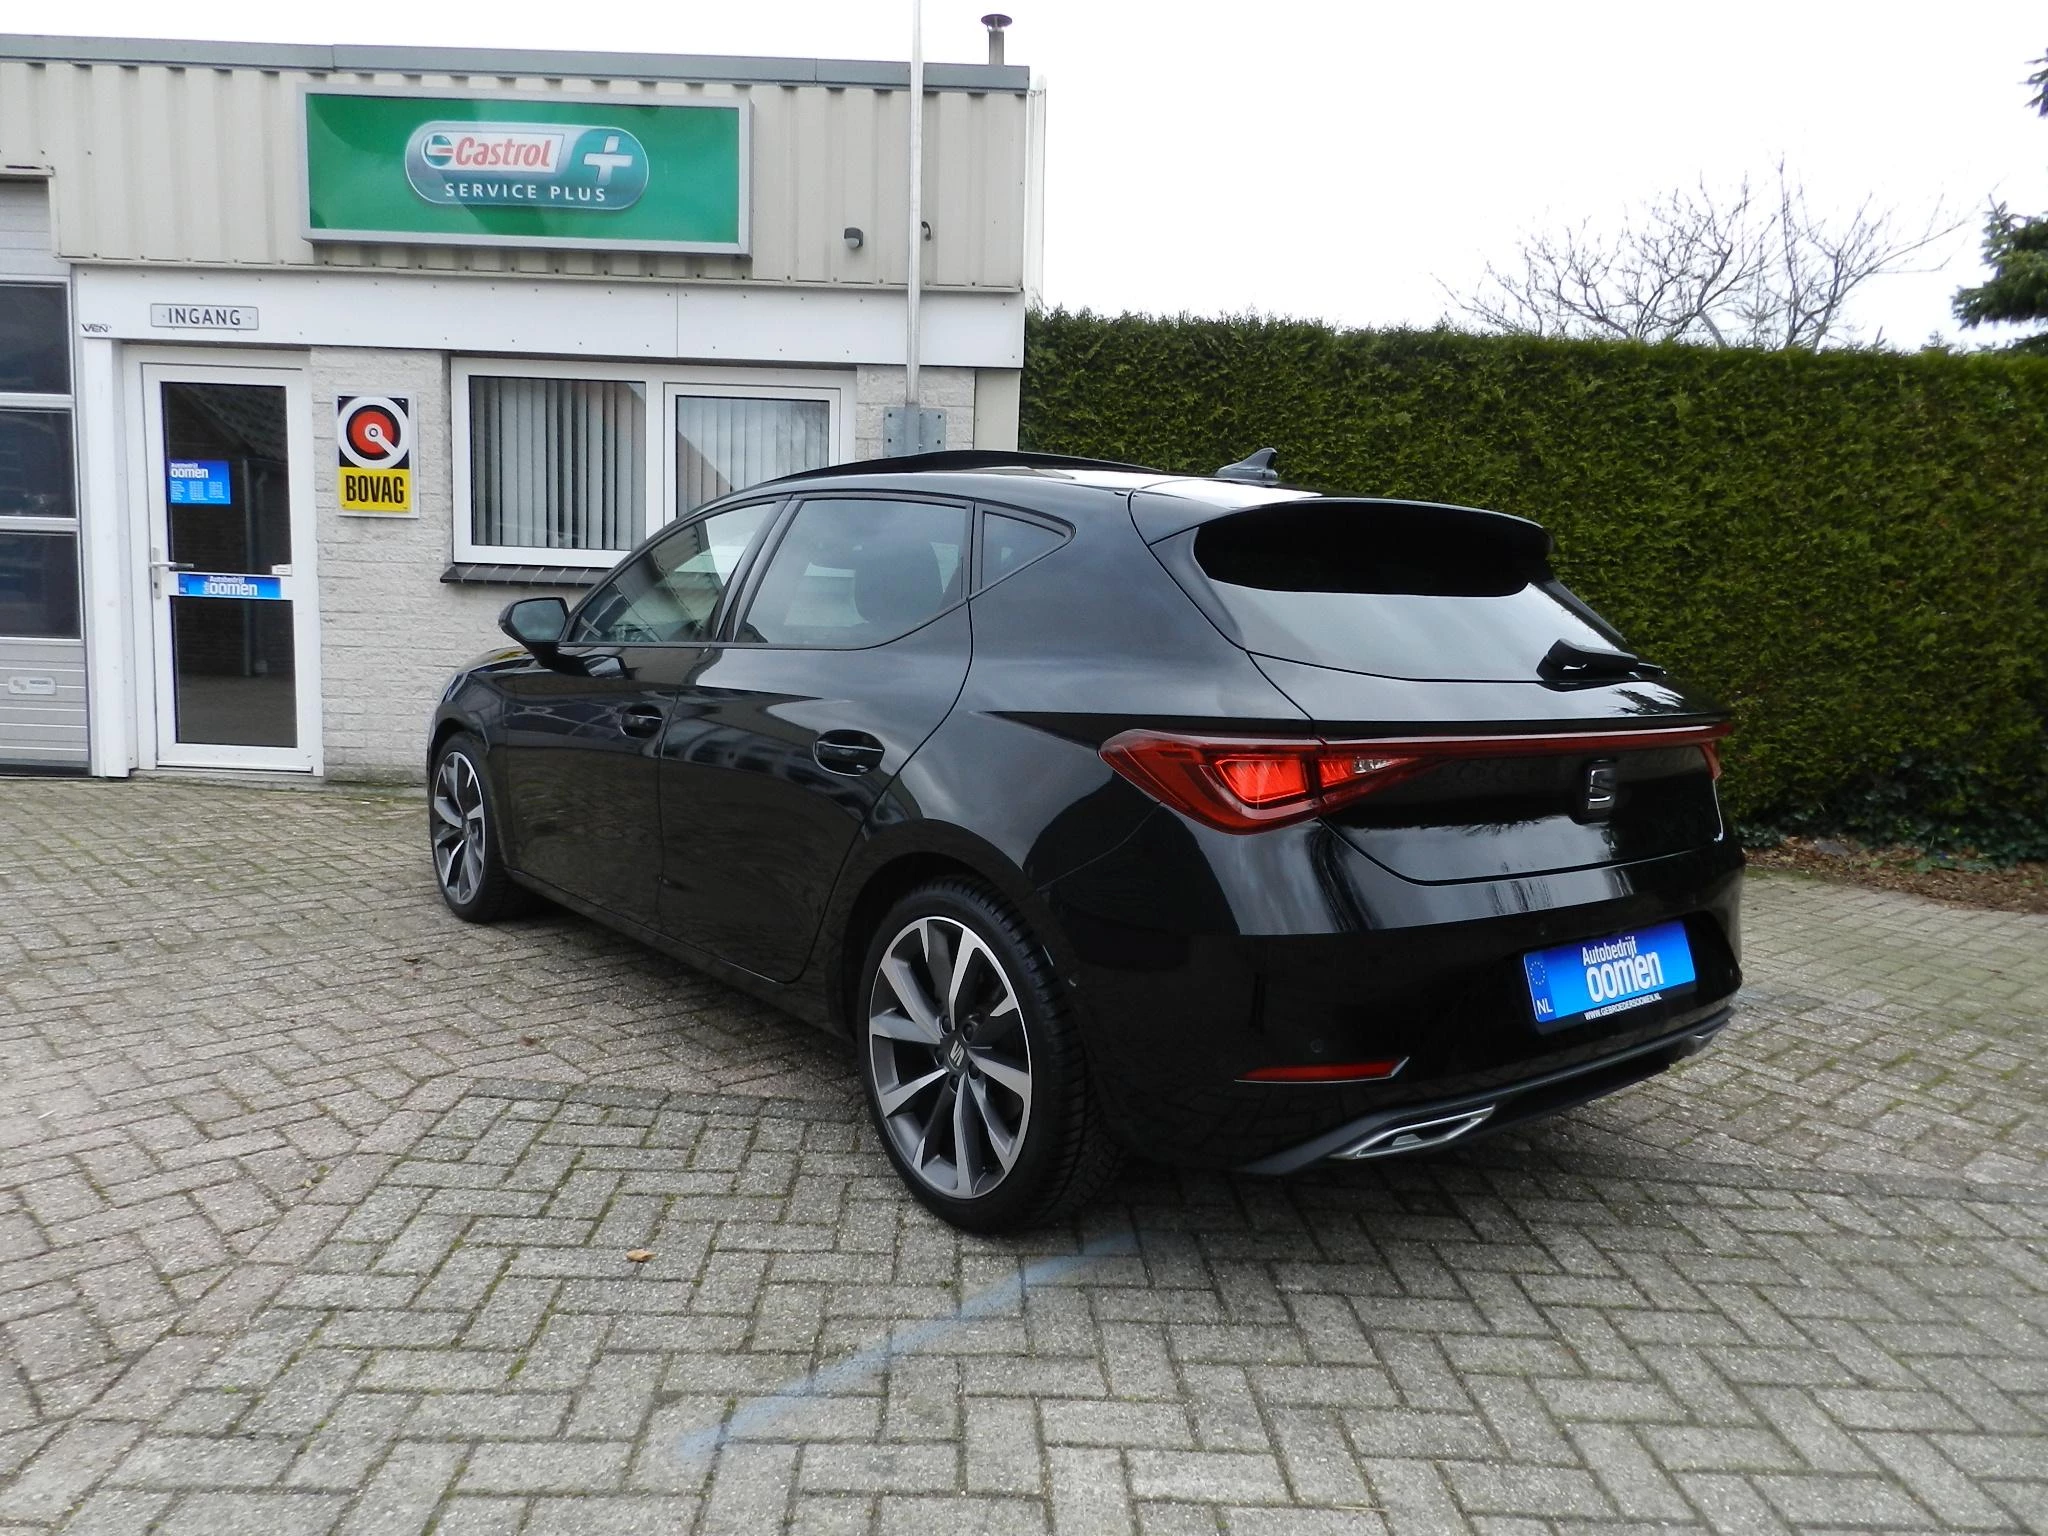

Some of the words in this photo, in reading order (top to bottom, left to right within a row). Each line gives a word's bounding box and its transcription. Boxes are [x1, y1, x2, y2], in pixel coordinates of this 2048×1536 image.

[455, 136, 552, 168] Castrol
[445, 183, 537, 199] SERVICE
[550, 185, 606, 202] PLUS
[168, 307, 241, 326] INGANG
[171, 468, 209, 479] oomen
[345, 475, 405, 504] BOVAG
[209, 582, 258, 597] oomen
[1582, 936, 1637, 966] Autobedrijf
[1586, 952, 1664, 1003] oomen
[1536, 997, 1553, 1015] NL
